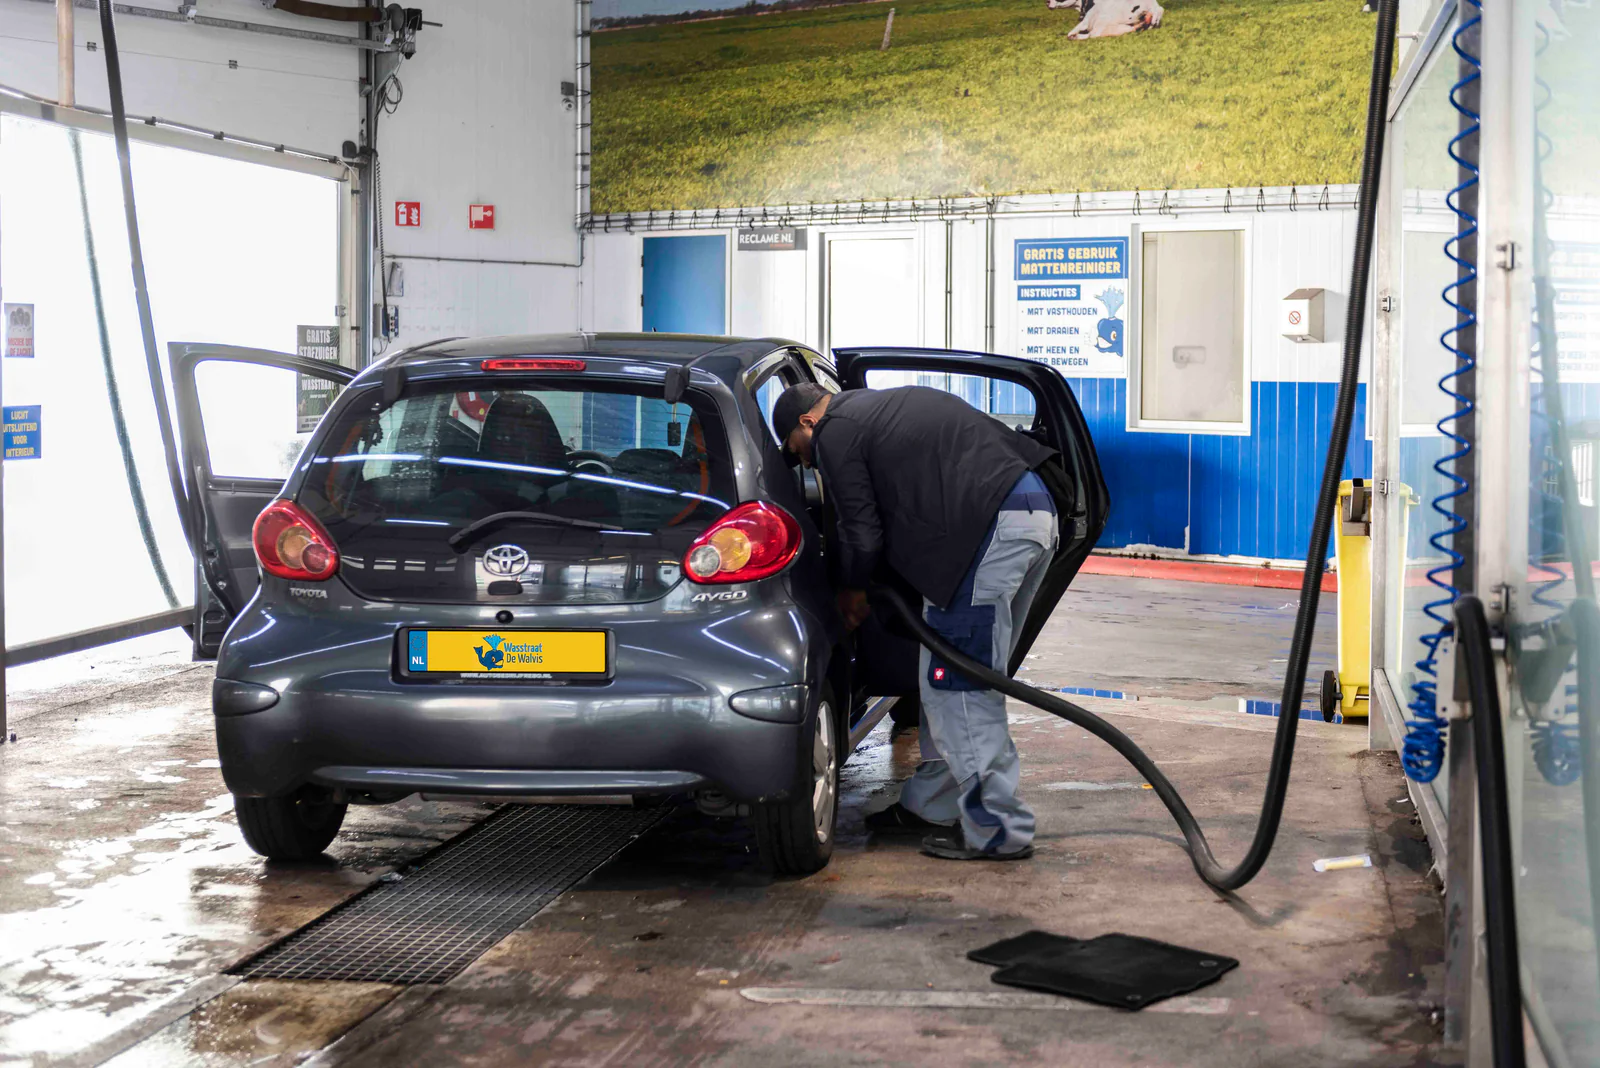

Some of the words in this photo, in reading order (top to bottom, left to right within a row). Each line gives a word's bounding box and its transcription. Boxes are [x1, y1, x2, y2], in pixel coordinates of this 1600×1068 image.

[739, 233, 780, 244] RECLAME
[781, 232, 794, 243] NL
[1023, 247, 1065, 261] GRATIS
[1068, 246, 1118, 260] GEBRUIK
[1020, 261, 1121, 275] MATTENREINIGER
[1020, 287, 1078, 298] INSTRUCTIES
[1027, 307, 1044, 316] MAT
[1046, 307, 1098, 316] VASTHOUDEN
[1027, 327, 1044, 335] MAT
[1046, 326, 1080, 335] DRAAIEN
[306, 329, 331, 344] GRATIS
[1027, 346, 1044, 354] MAT
[1046, 346, 1067, 354] HEEN
[1069, 346, 1080, 354] EN
[1051, 357, 1089, 366] BEWEGEN
[11, 410, 29, 420] LUCHT
[12, 435, 28, 445] VOOR
[289, 587, 329, 599] TOYOTA
[691, 590, 748, 603] AYGO
[504, 642, 543, 653] Wasstraat
[412, 656, 425, 665] NL
[506, 653, 516, 664] De
[518, 653, 543, 664] Walvis
